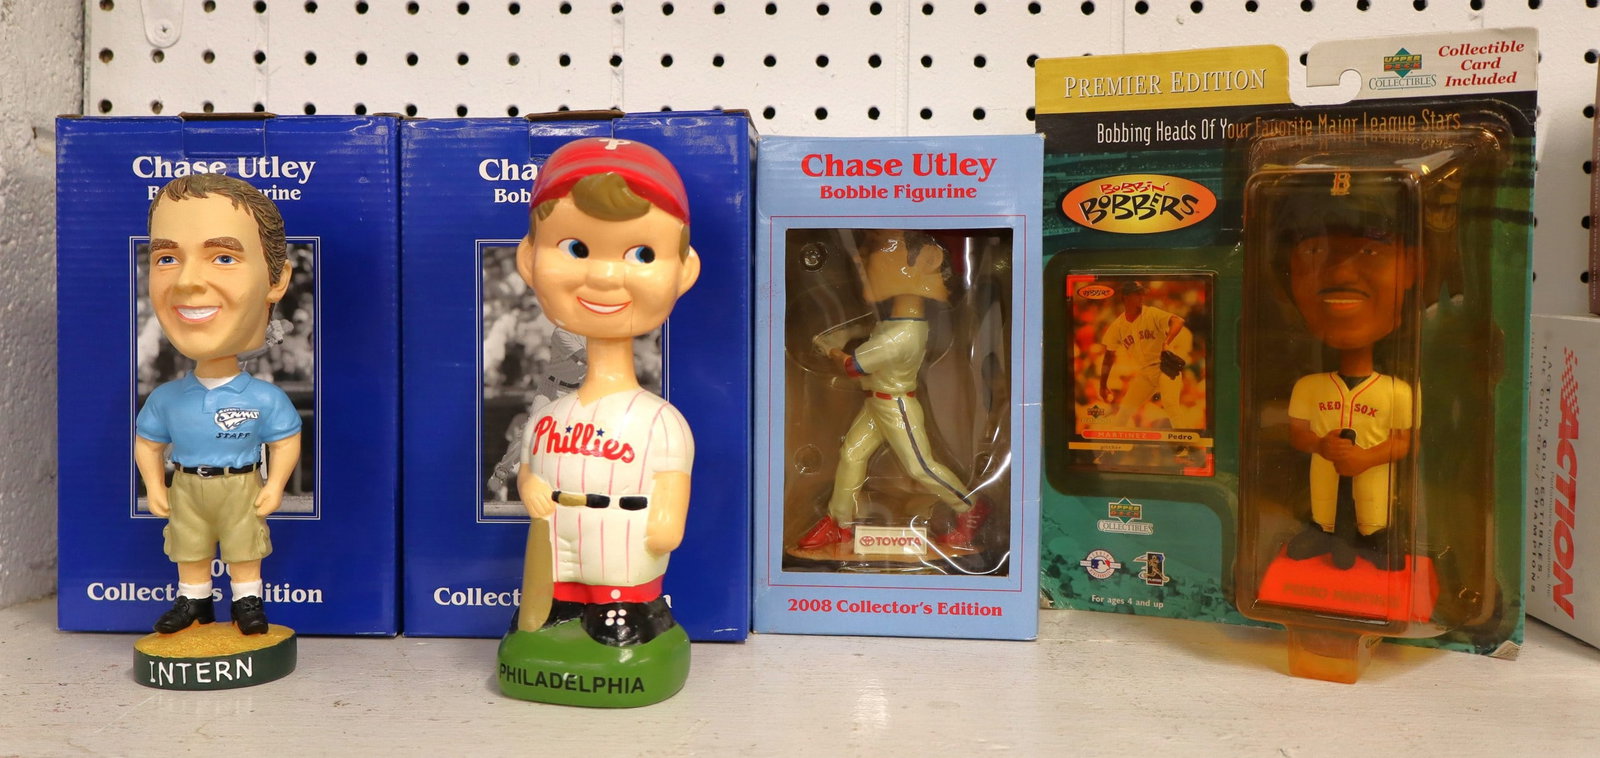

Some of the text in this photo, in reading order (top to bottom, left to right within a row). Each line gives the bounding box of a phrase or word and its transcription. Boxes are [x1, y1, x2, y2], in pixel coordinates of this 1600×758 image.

[1438, 40, 1525, 57] Collectible
[1460, 57, 1501, 71] Card
[1444, 72, 1517, 87] Included
[1097, 121, 1151, 146] Bobbing
[1156, 120, 1197, 142] Heads
[1201, 118, 1216, 140] Of
[1220, 118, 1250, 139] Your
[1255, 116, 1313, 137] Favorite
[1363, 112, 1416, 134] League
[1421, 108, 1461, 131] Stars
[132, 156, 316, 184] Chase Utley
[478, 158, 539, 181] Cha
[801, 152, 997, 182] Chase Utley
[494, 188, 531, 203] Bob
[820, 184, 977, 202] Bobble Figurine
[1079, 192, 1200, 224] BOBBERS
[1319, 402, 1378, 417] RED SOX
[532, 415, 635, 463] Phillies
[1552, 387, 1579, 620] ACTION
[876, 536, 922, 547] TOYOTA
[261, 583, 323, 603] ition
[433, 587, 522, 607] Collect
[1091, 595, 1105, 603] For
[1107, 597, 1124, 606] ages
[1154, 601, 1164, 610] up
[787, 598, 1003, 617] 2008 Collector's Edition
[149, 656, 254, 686] INTERN
[500, 662, 645, 694] PHILADELPHIA
